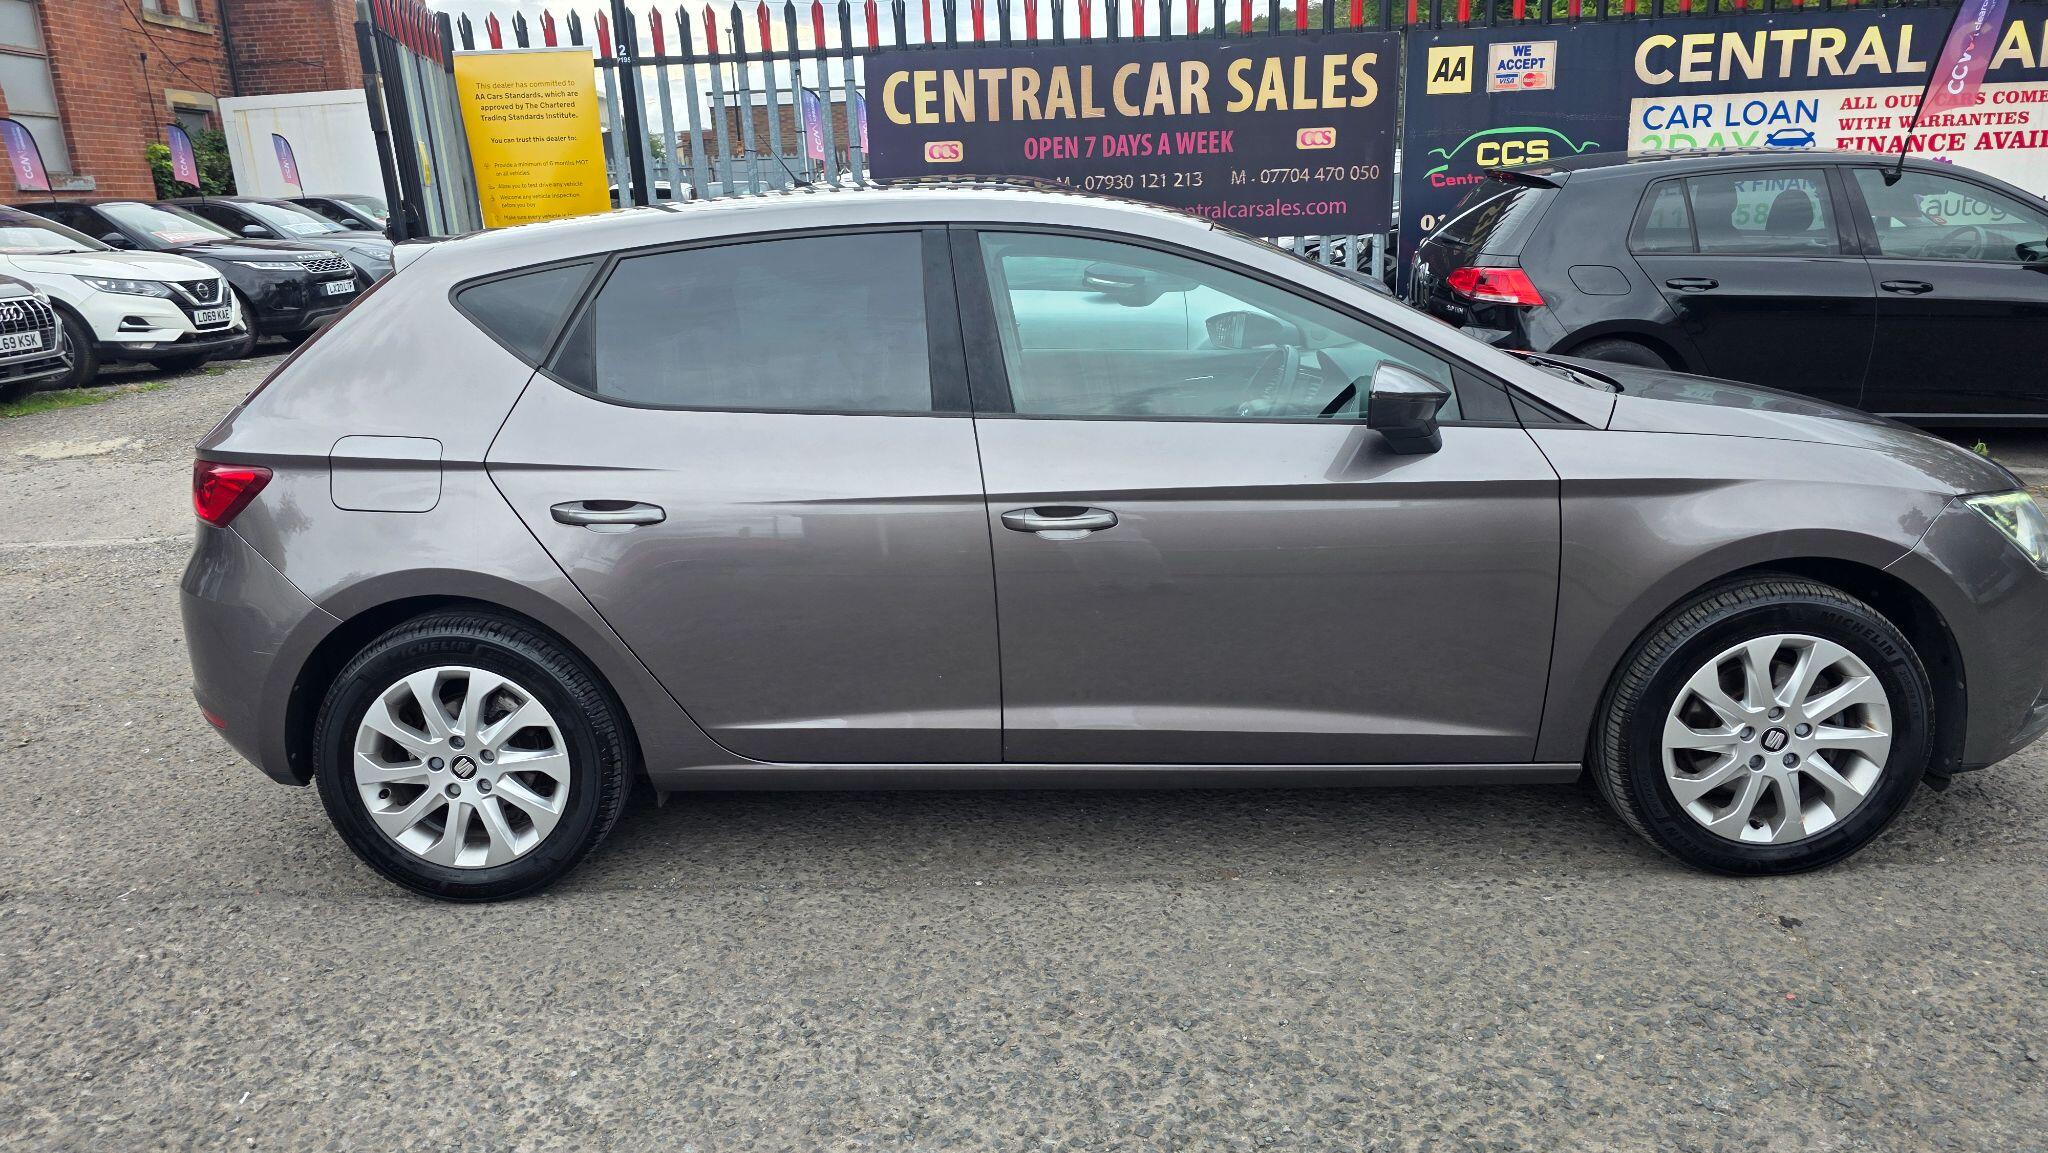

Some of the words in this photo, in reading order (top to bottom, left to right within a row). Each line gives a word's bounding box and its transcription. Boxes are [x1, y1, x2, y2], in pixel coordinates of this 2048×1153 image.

[618, 44, 626, 56] 2
[1513, 45, 1532, 56] WE
[1634, 24, 1926, 85] CENTRAL
[1432, 56, 1466, 82] AA
[1498, 58, 1545, 70] ACCEPT
[530, 80, 566, 88] committed
[882, 64, 1106, 124] CENTRAL
[1112, 60, 1210, 117] CAR
[1227, 52, 1378, 113] SALES
[515, 102, 524, 110] by
[1840, 96, 1878, 110] ALL
[1993, 90, 2048, 105] COME
[481, 114, 506, 122] Trading
[1642, 104, 1712, 130] CAR
[1726, 99, 1819, 127] LOAN
[1839, 116, 1891, 130] WITH
[1899, 111, 2030, 128] WARRANTIES
[1024, 136, 1078, 160] OPEN
[1084, 136, 1097, 158] 7
[1103, 133, 1152, 158] DAYS
[1158, 133, 1170, 155] A
[1176, 130, 1234, 154] WEEK
[1836, 133, 1966, 153] FINANCE
[1476, 140, 1549, 166] CCS
[1085, 175, 1134, 190] 07930
[1141, 174, 1166, 188] 121
[1174, 172, 1203, 187] 213
[1231, 170, 1246, 185] M
[1260, 168, 1309, 184] 07704
[1314, 166, 1344, 182] 470
[1350, 165, 1379, 180] 050
[1431, 174, 1487, 187] Centr
[1181, 198, 1347, 219] ntralcarsales.com
[217, 309, 230, 320] KAE
[18, 334, 37, 347] KSK
[1822, 611, 1897, 657] MICHELIN
